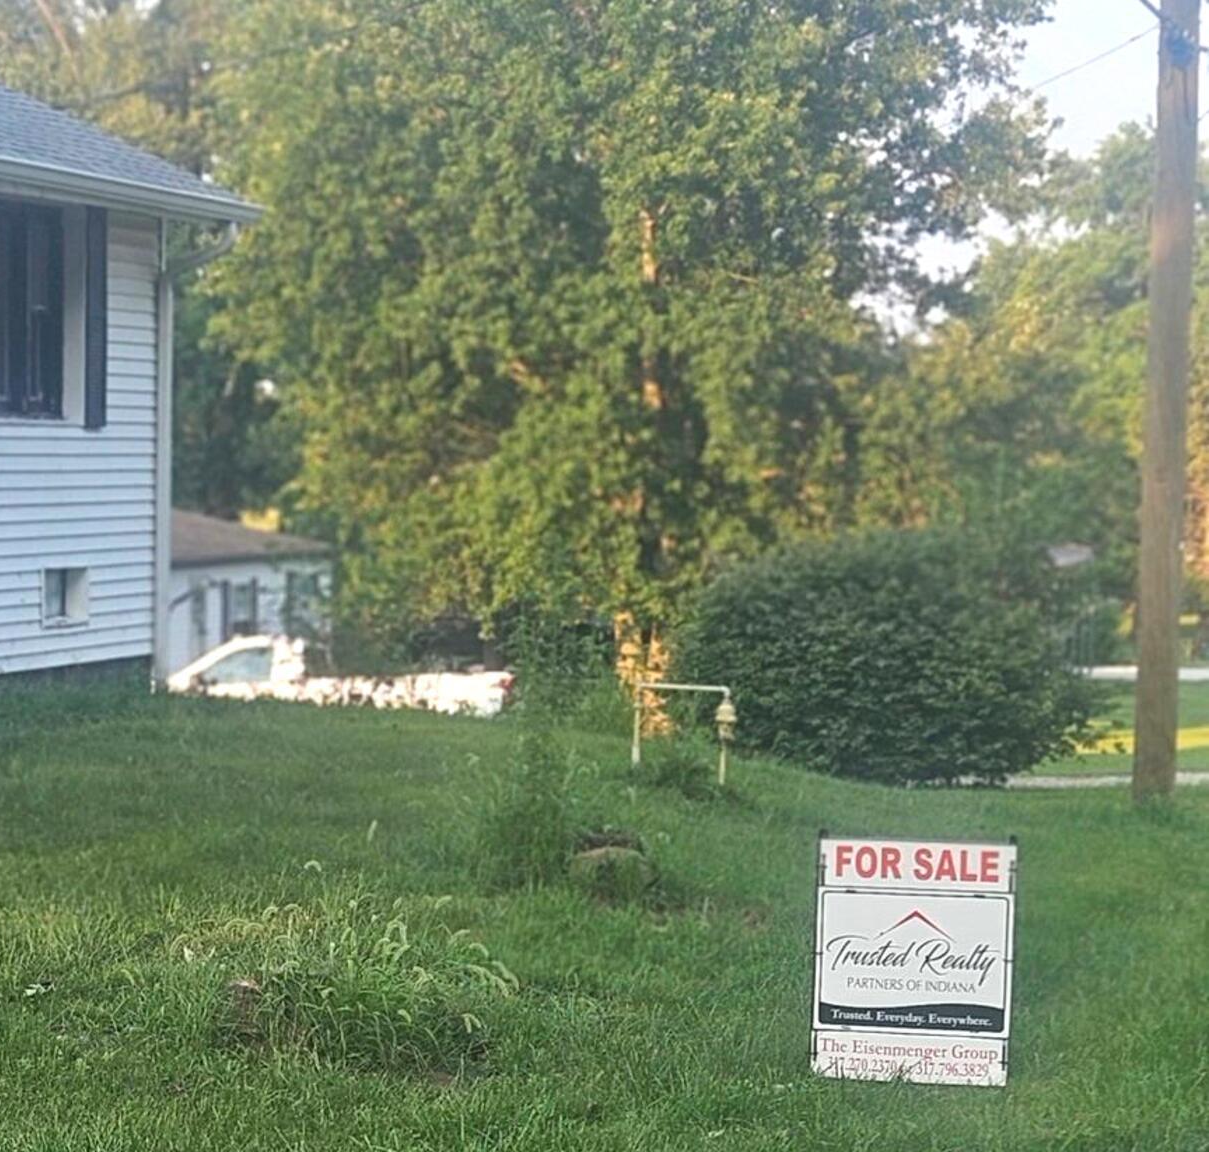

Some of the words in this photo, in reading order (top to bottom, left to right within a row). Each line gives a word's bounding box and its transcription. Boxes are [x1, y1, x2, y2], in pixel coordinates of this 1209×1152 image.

[835, 844, 902, 880] FOR
[913, 847, 1000, 883] SALE
[826, 934, 916, 971] Trusted
[915, 938, 1000, 986] Realty
[846, 977, 904, 992] PARTNERS
[906, 979, 922, 992] OF
[925, 980, 977, 994] INDIANA
[830, 1008, 874, 1021] Trusted.
[876, 1010, 927, 1026] Everyday.
[928, 1012, 993, 1028] Everywhere.
[820, 1037, 848, 1053] The
[852, 1039, 947, 1062] Eisenmenger
[951, 1044, 999, 1065] Group
